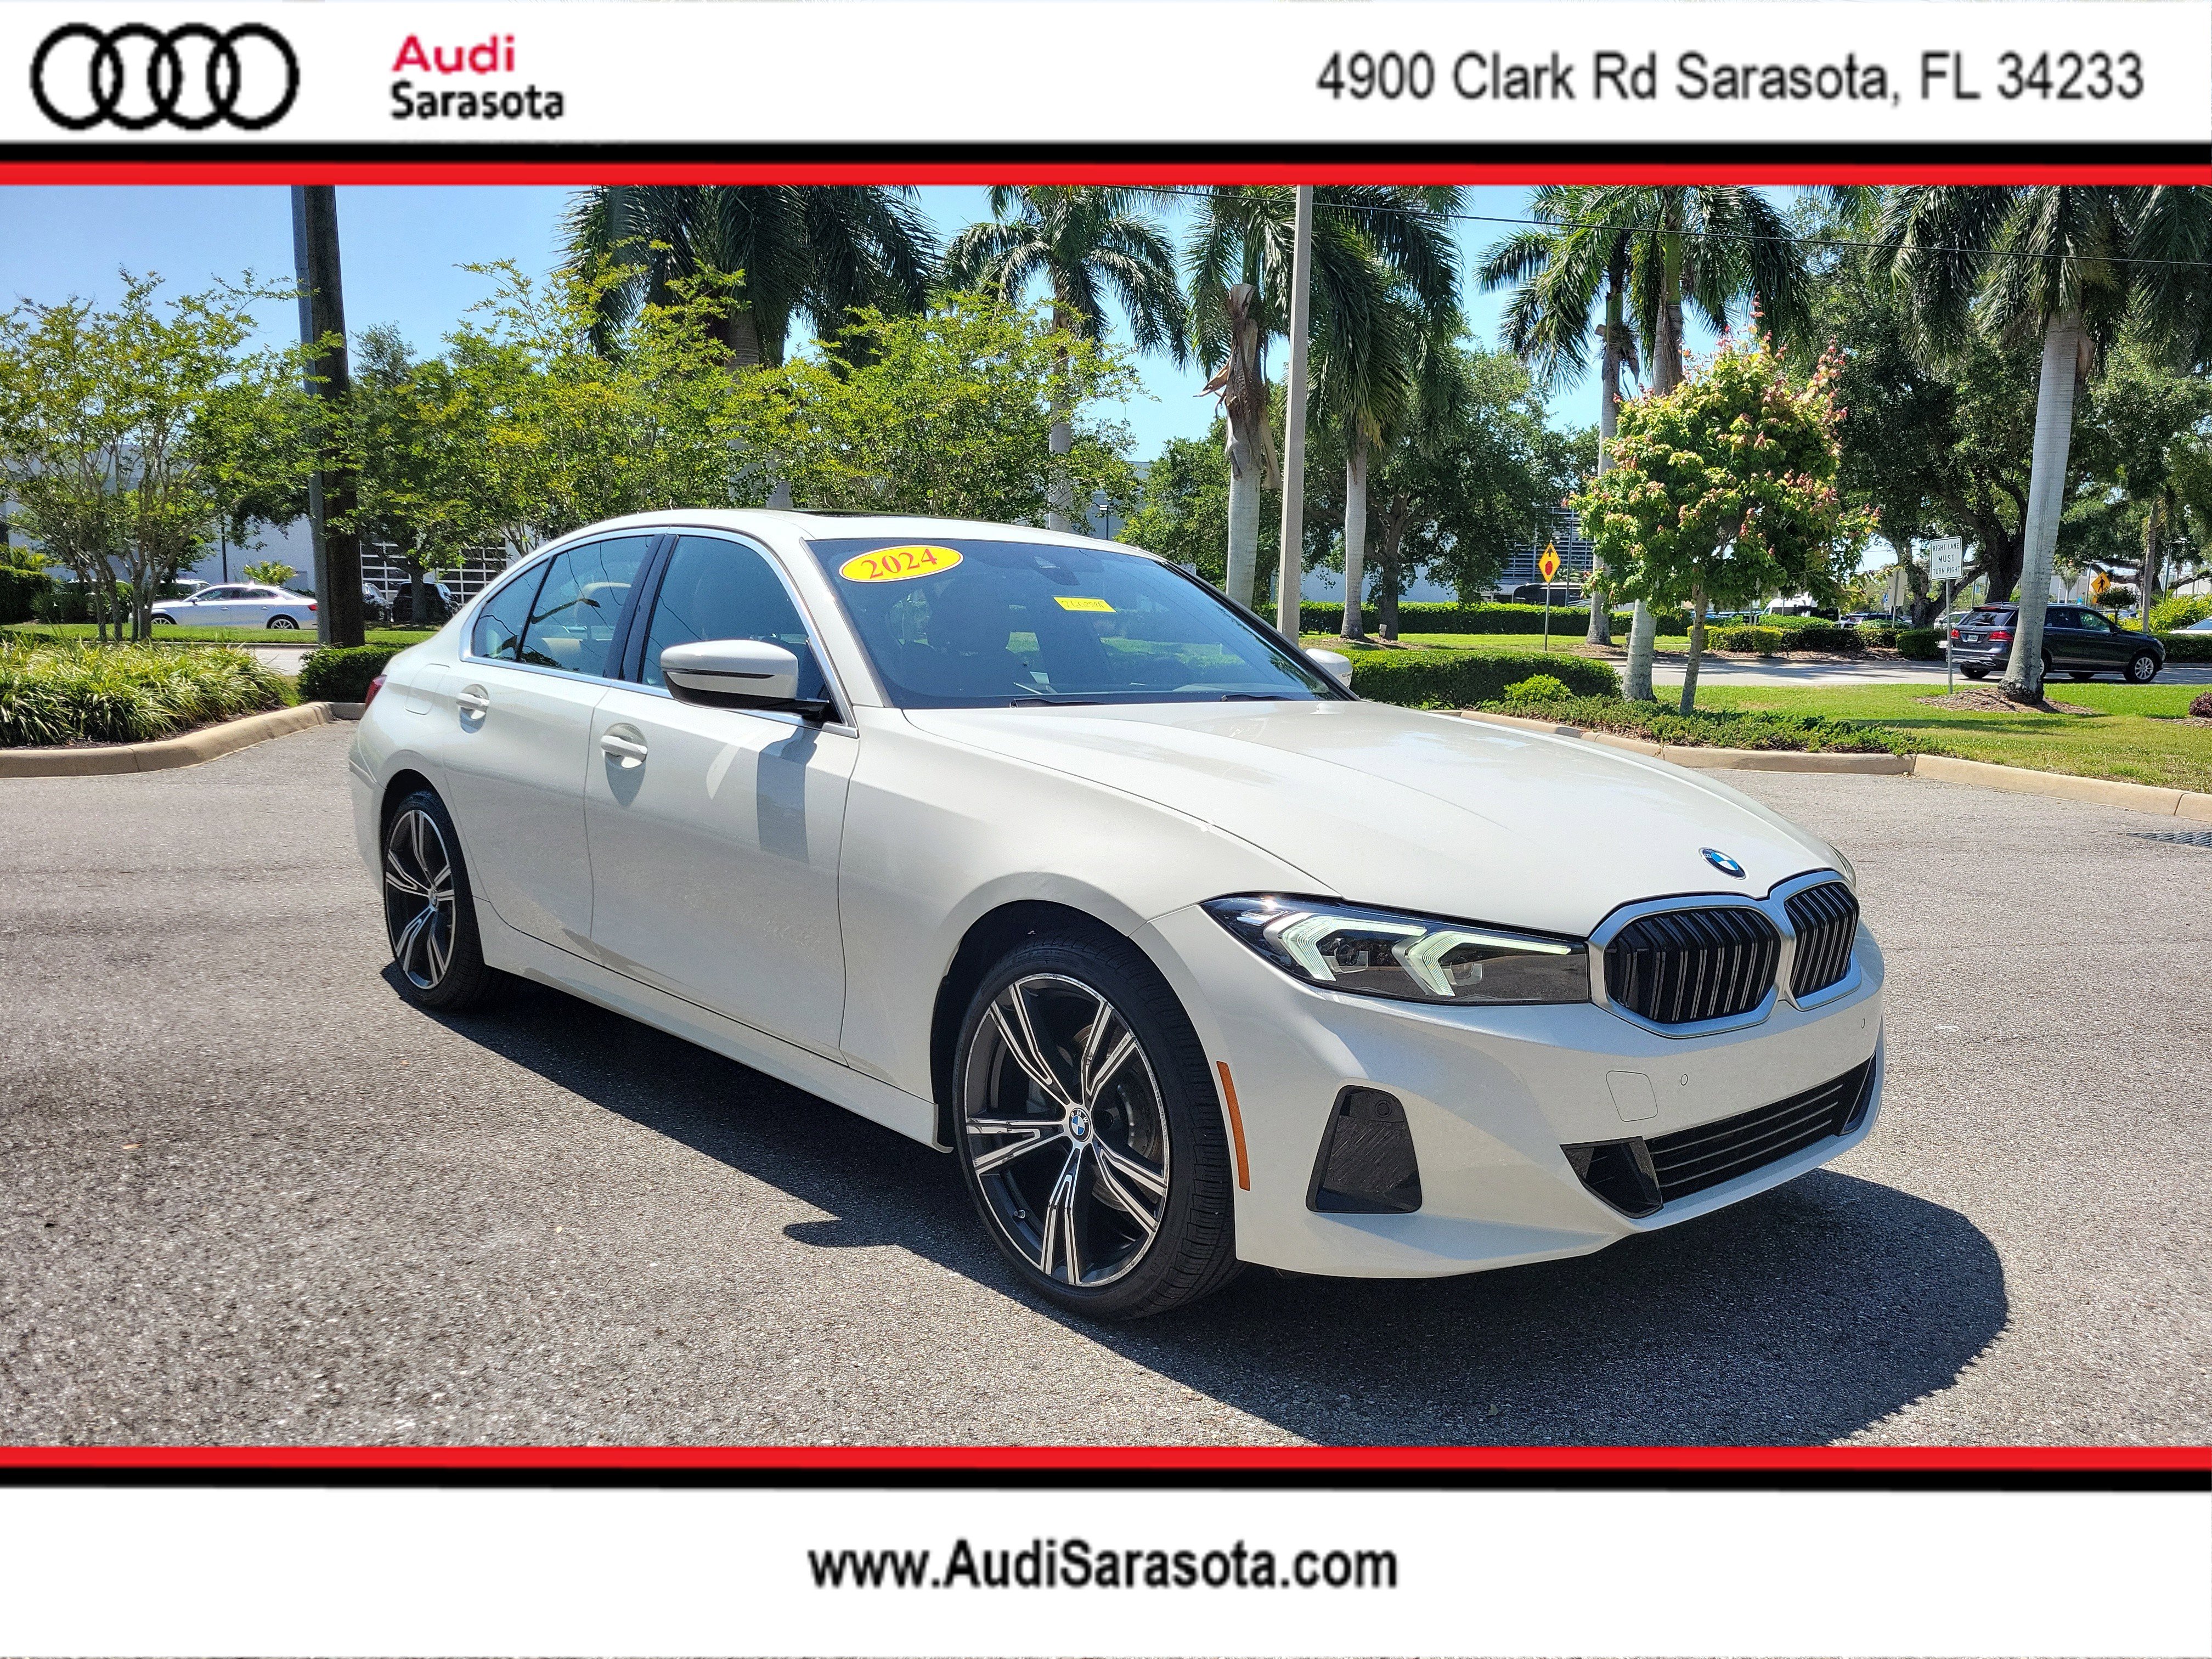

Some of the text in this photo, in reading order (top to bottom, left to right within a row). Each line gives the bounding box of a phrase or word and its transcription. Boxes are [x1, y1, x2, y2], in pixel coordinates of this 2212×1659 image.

[861, 548, 938, 579] 2024
[1938, 554, 1955, 563] MUST
[1070, 1110, 1088, 1124] BMW
